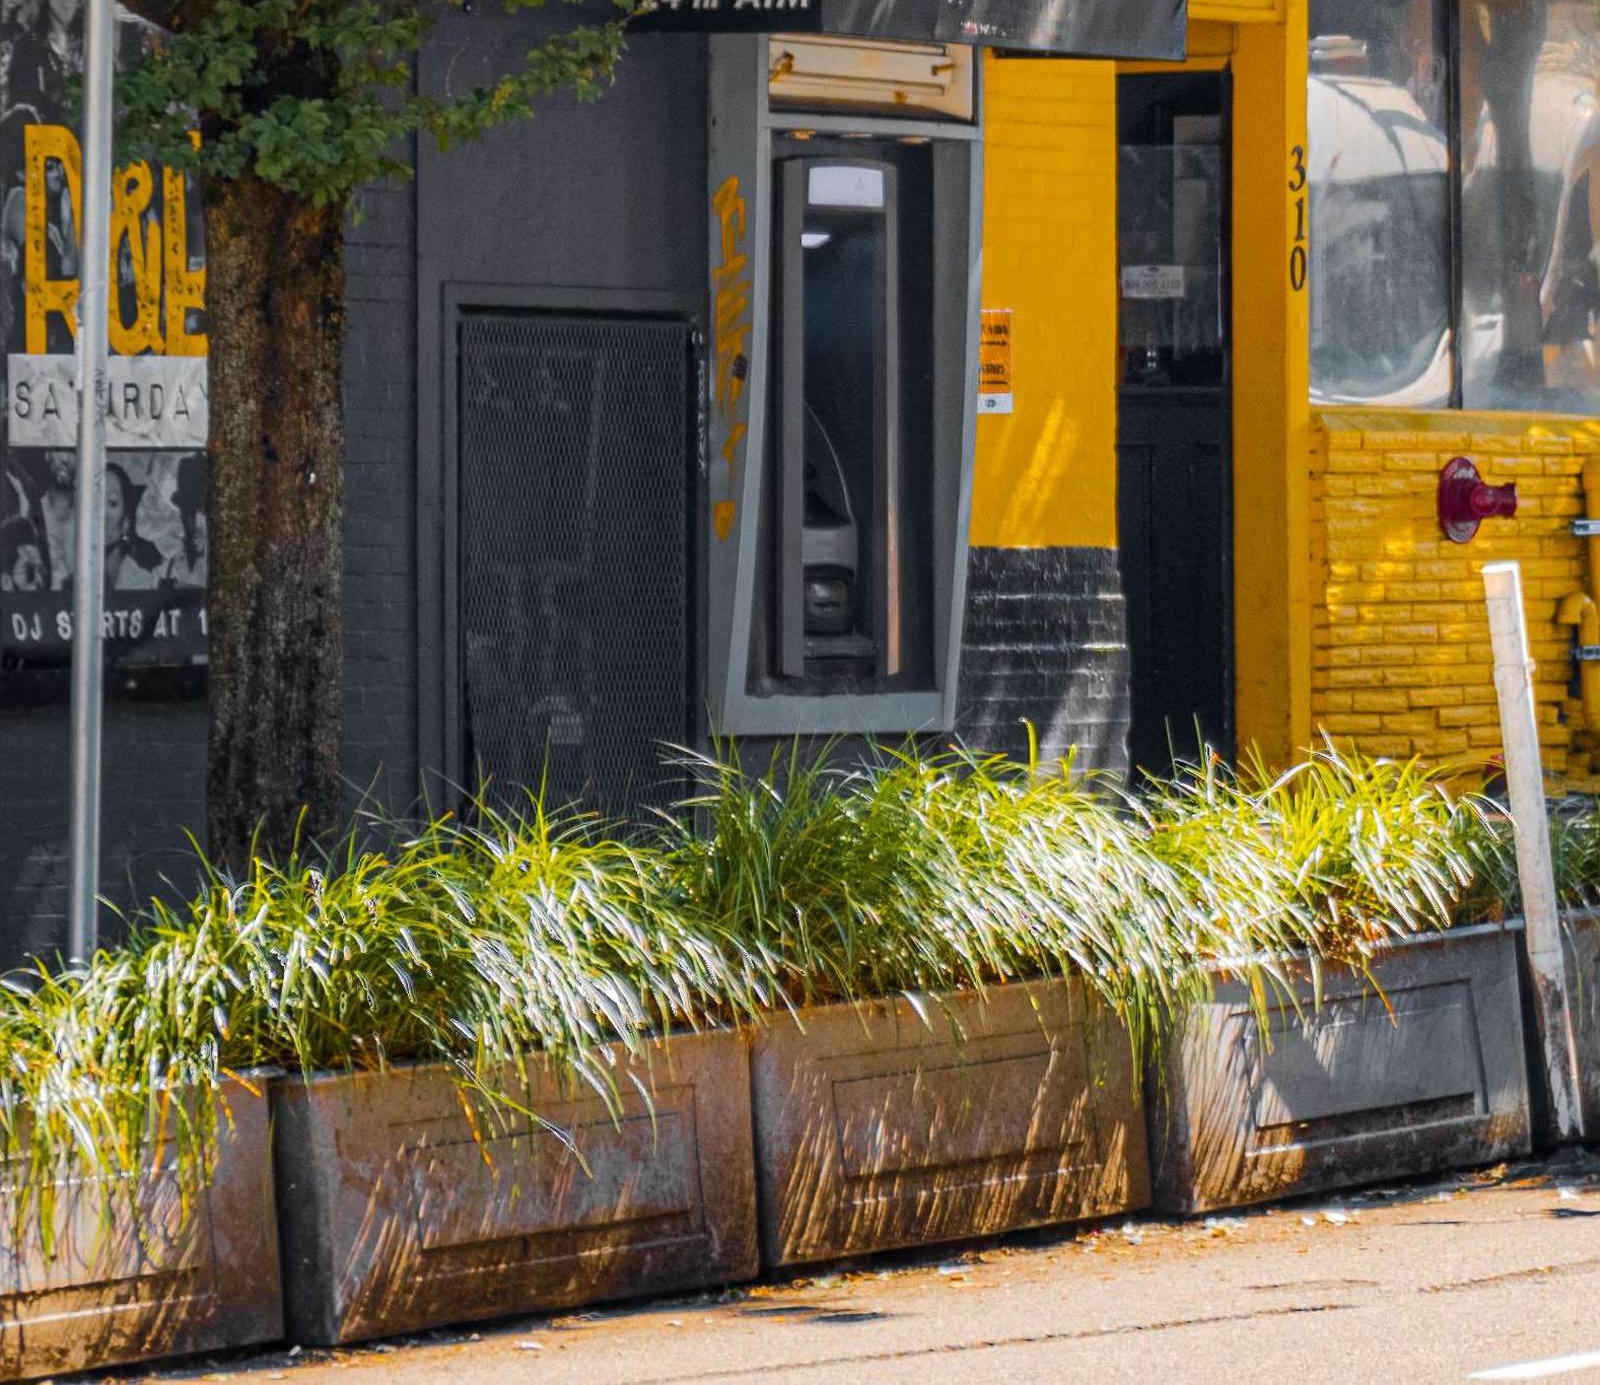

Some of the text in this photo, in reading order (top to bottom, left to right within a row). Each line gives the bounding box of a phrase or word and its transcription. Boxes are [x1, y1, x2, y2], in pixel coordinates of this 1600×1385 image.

[1288, 145, 1307, 292] 310
[14, 380, 208, 421] SARDA
[12, 612, 42, 641] DJ
[55, 609, 143, 640] SRTS
[153, 608, 181, 639] AT
